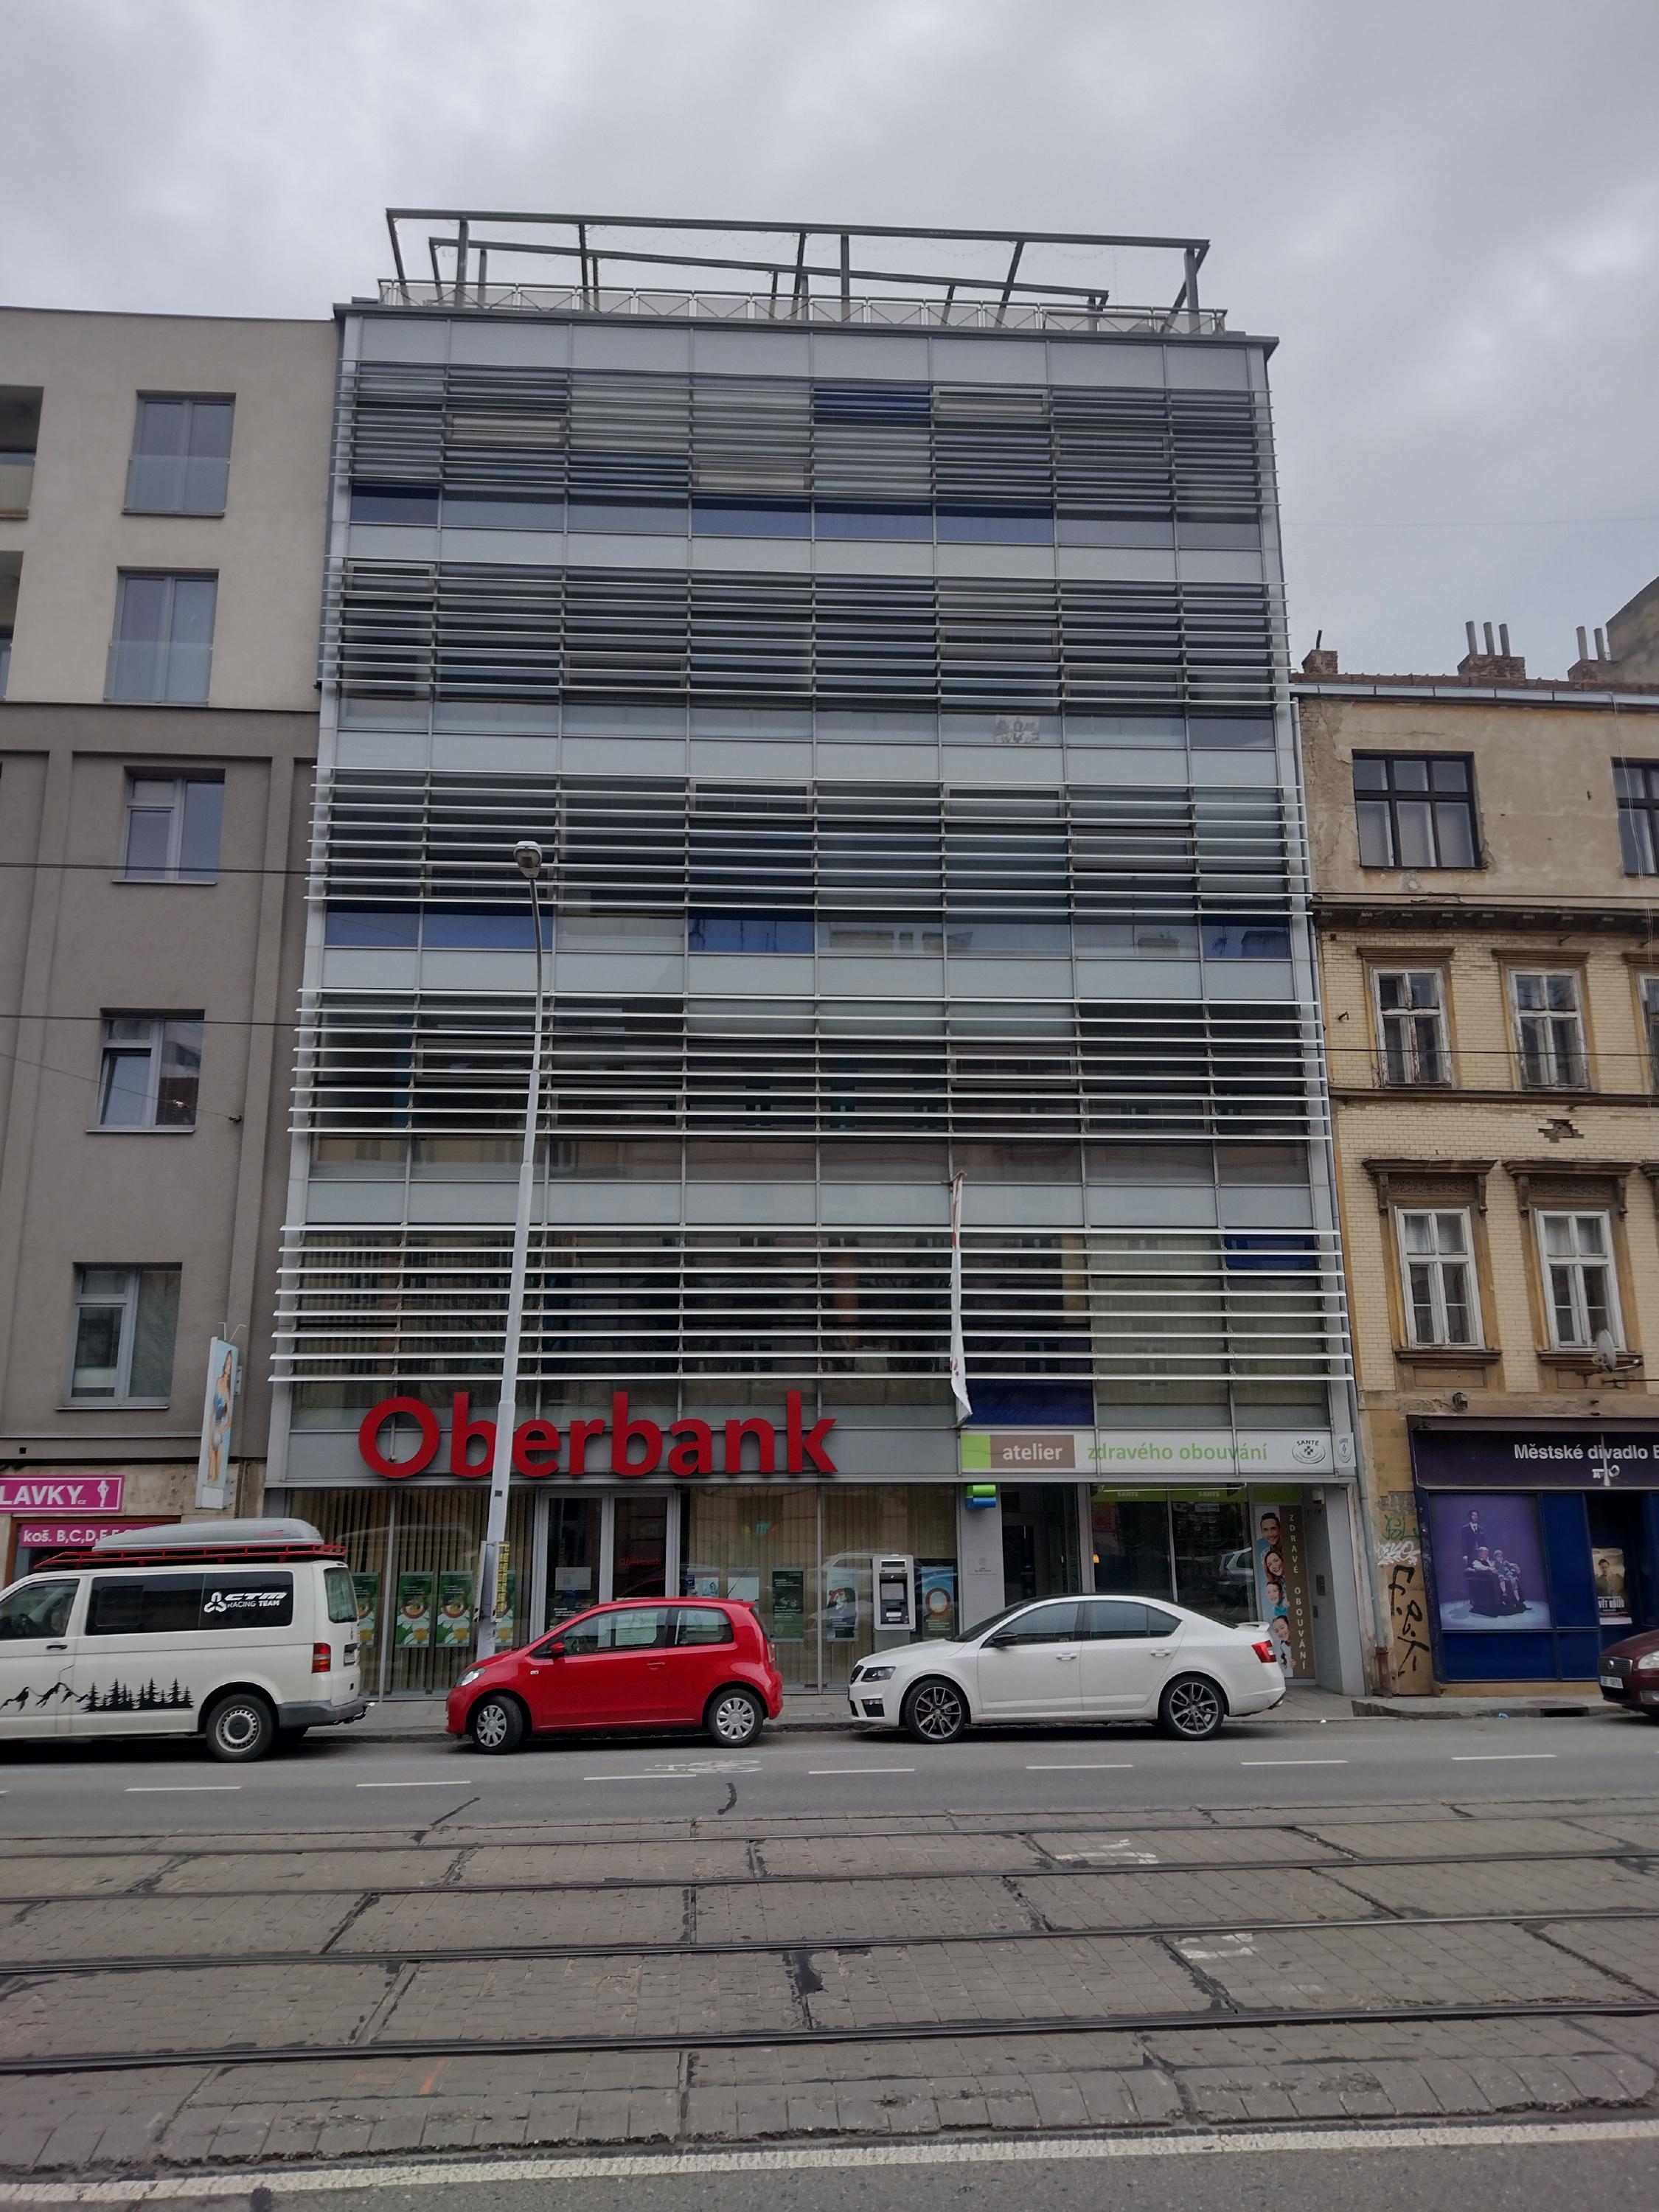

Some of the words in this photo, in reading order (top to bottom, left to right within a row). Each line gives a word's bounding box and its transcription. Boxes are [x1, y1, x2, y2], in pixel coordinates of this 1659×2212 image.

[358, 1390, 838, 1478] Oberbank
[1002, 1443, 1062, 1460] atelier
[1088, 1443, 1173, 1460] zdravého
[1180, 1442, 1267, 1460] obouvání
[1514, 1443, 1584, 1459] Městské
[1587, 1445, 1649, 1459] divadlo
[24, 1529, 52, 1542] koš.
[1289, 1514, 1299, 1573] ZDRAVÉ
[224, 1593, 288, 1601] CTM
[1294, 1587, 1307, 1670] OBOUVÁNÍ
